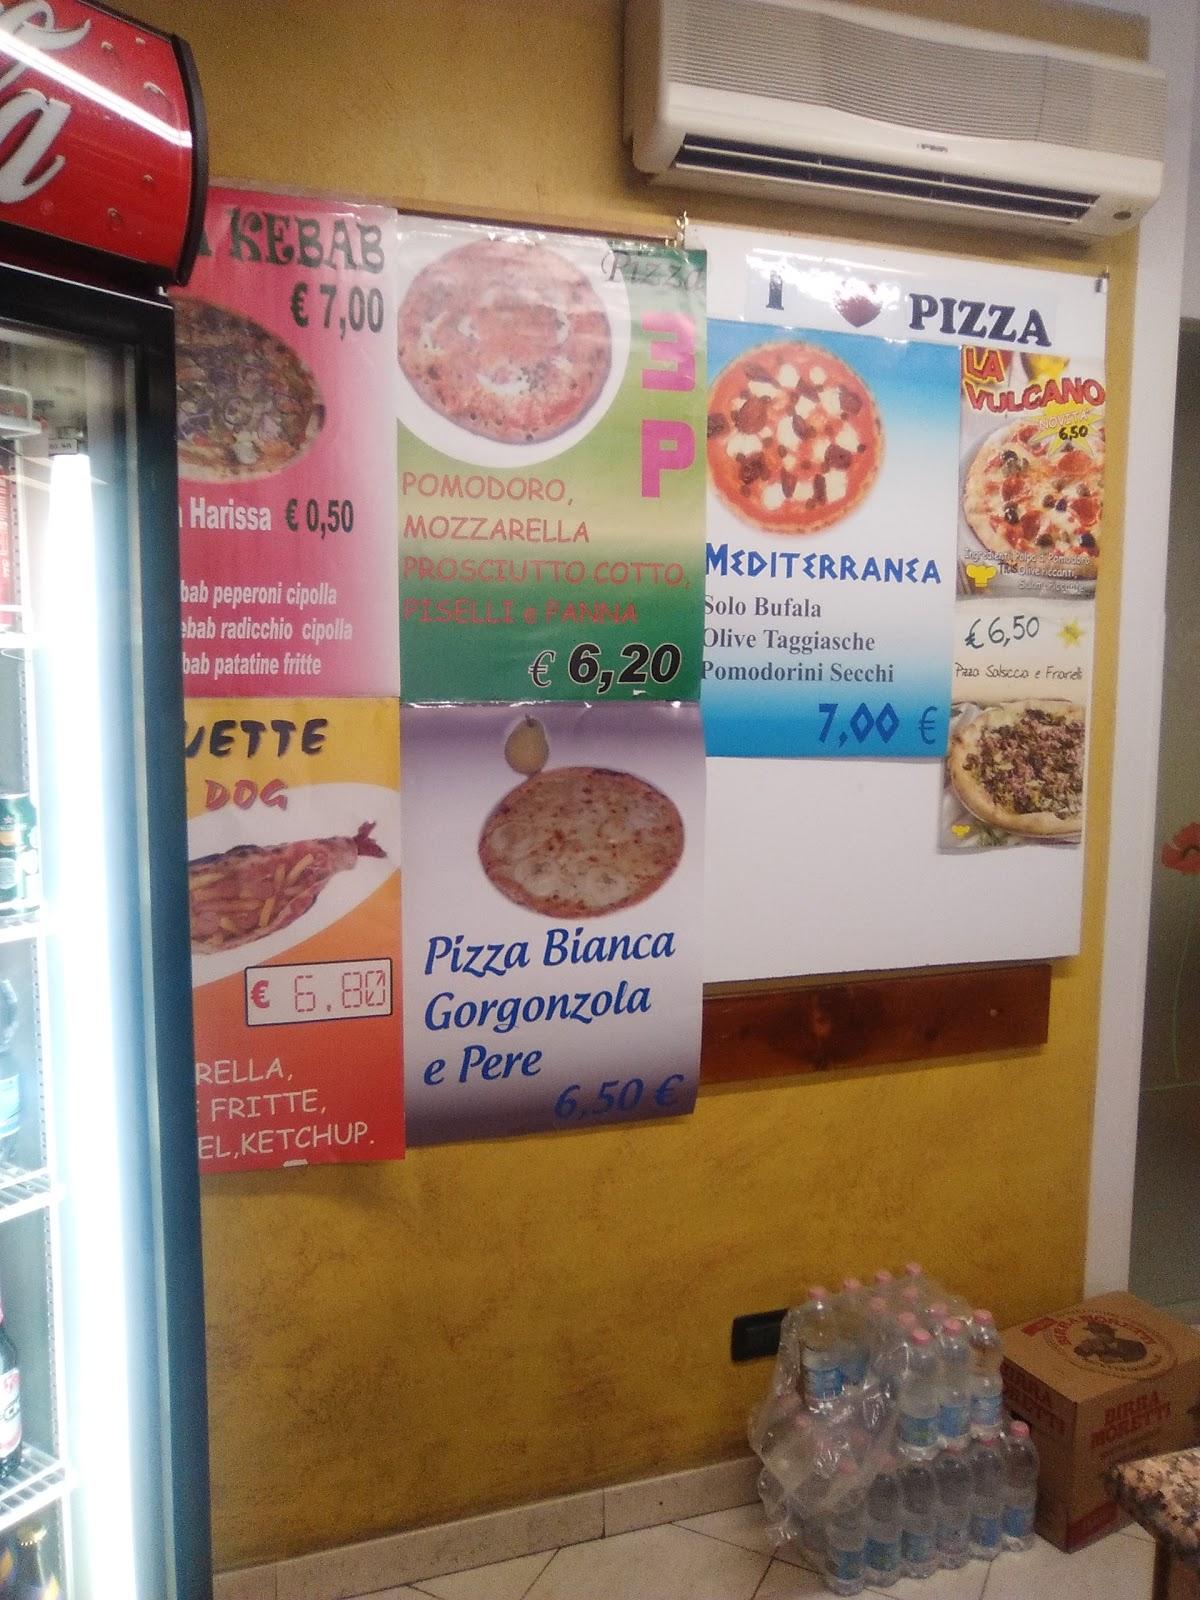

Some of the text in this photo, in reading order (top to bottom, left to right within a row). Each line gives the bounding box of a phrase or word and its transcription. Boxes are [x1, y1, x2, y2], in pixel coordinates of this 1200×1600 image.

[228, 206, 385, 275] KEBAB
[290, 282, 385, 341] € 7,00
[909, 292, 1052, 348] PIZZA
[964, 347, 1005, 382] LA
[963, 377, 1106, 414] VULCANO
[1058, 425, 1089, 441] 6,50
[402, 471, 574, 506] POMODORO,
[190, 497, 272, 531] Harissa
[286, 498, 299, 532] €
[306, 499, 354, 540] 0,50
[403, 514, 591, 544] MOZZARELLA
[402, 555, 586, 585] PROSCIUTTO
[705, 542, 942, 585] MEDITERRANEA
[180, 580, 337, 610] bab peperoni cipolla
[402, 598, 638, 625] PISELLI e PANNA
[703, 595, 822, 618] Solo Bufala
[181, 616, 352, 645] ebab radicchio cipolla
[703, 628, 876, 655] Olive Taggiasche
[965, 615, 1040, 648] € 6,50
[182, 652, 322, 680] bab patatine fritte
[528, 643, 682, 694] € 6,20
[702, 660, 894, 683] Pomodorini Secchi
[184, 718, 328, 758] UETTE
[818, 702, 938, 748] 7,00 €
[205, 778, 288, 811] DOG
[424, 927, 676, 977] Pizza Bianca
[250, 980, 270, 1009] €
[424, 980, 651, 1033] Gorgonzola
[195, 1057, 293, 1085] RELLA,
[423, 1044, 543, 1085] e Pere
[211, 1089, 326, 1122] FRITTE,
[197, 1121, 374, 1160] EL,KETCHUP.
